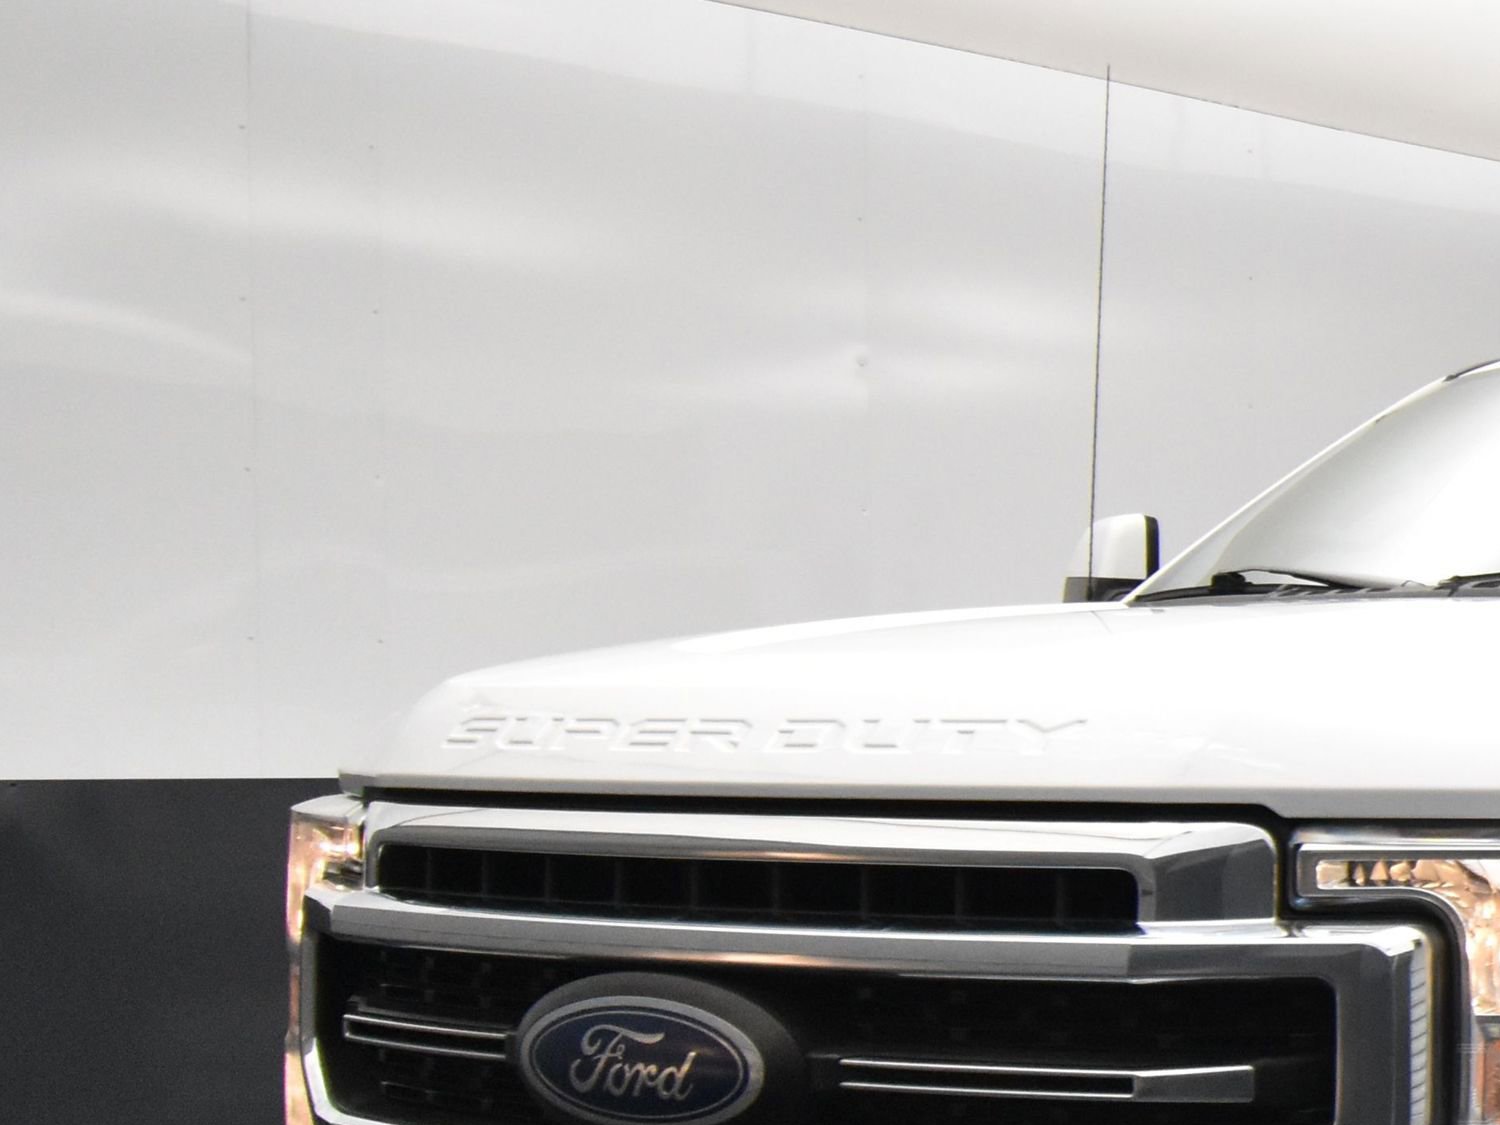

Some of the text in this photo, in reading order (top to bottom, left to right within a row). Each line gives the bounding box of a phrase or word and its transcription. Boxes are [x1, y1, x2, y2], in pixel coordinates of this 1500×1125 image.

[442, 715, 1088, 755] SUPER DUTY
[569, 1024, 697, 1101] Ford
